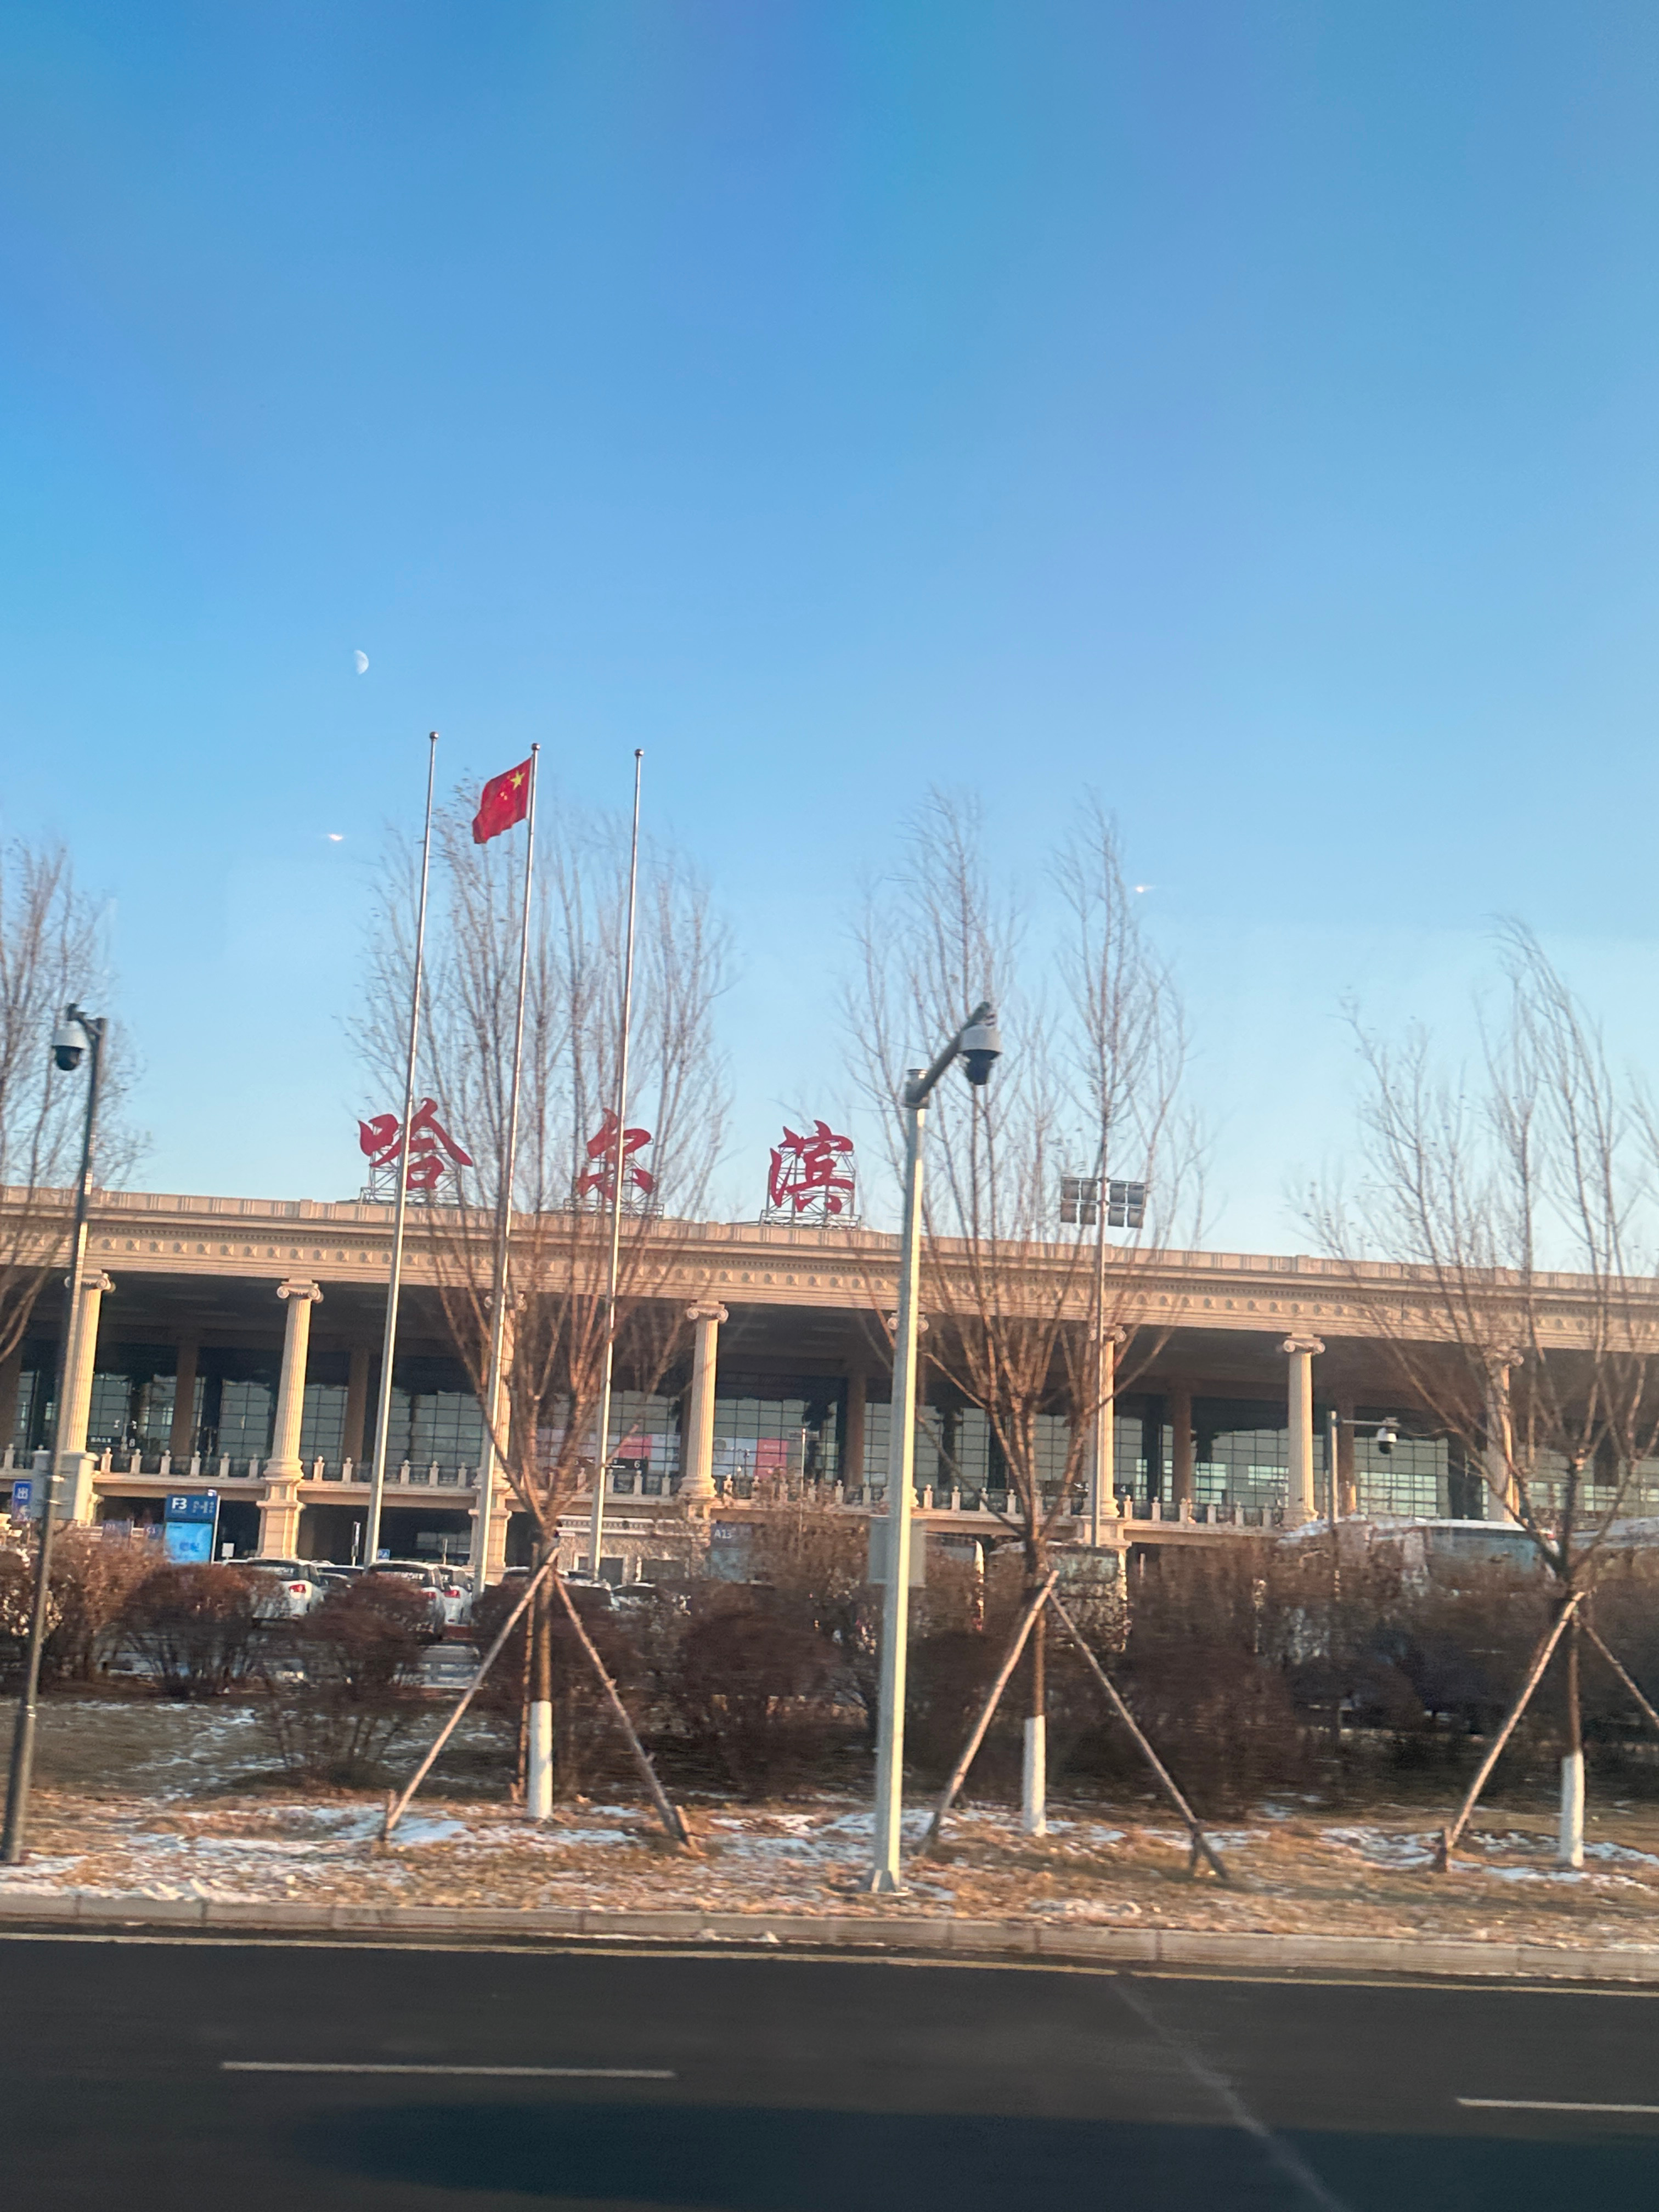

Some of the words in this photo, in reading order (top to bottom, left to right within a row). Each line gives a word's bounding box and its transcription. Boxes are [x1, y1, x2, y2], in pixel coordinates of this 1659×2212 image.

[129, 1438, 135, 1447] 8
[18, 1487, 28, 1499] 出
[172, 1497, 188, 1510] F3
